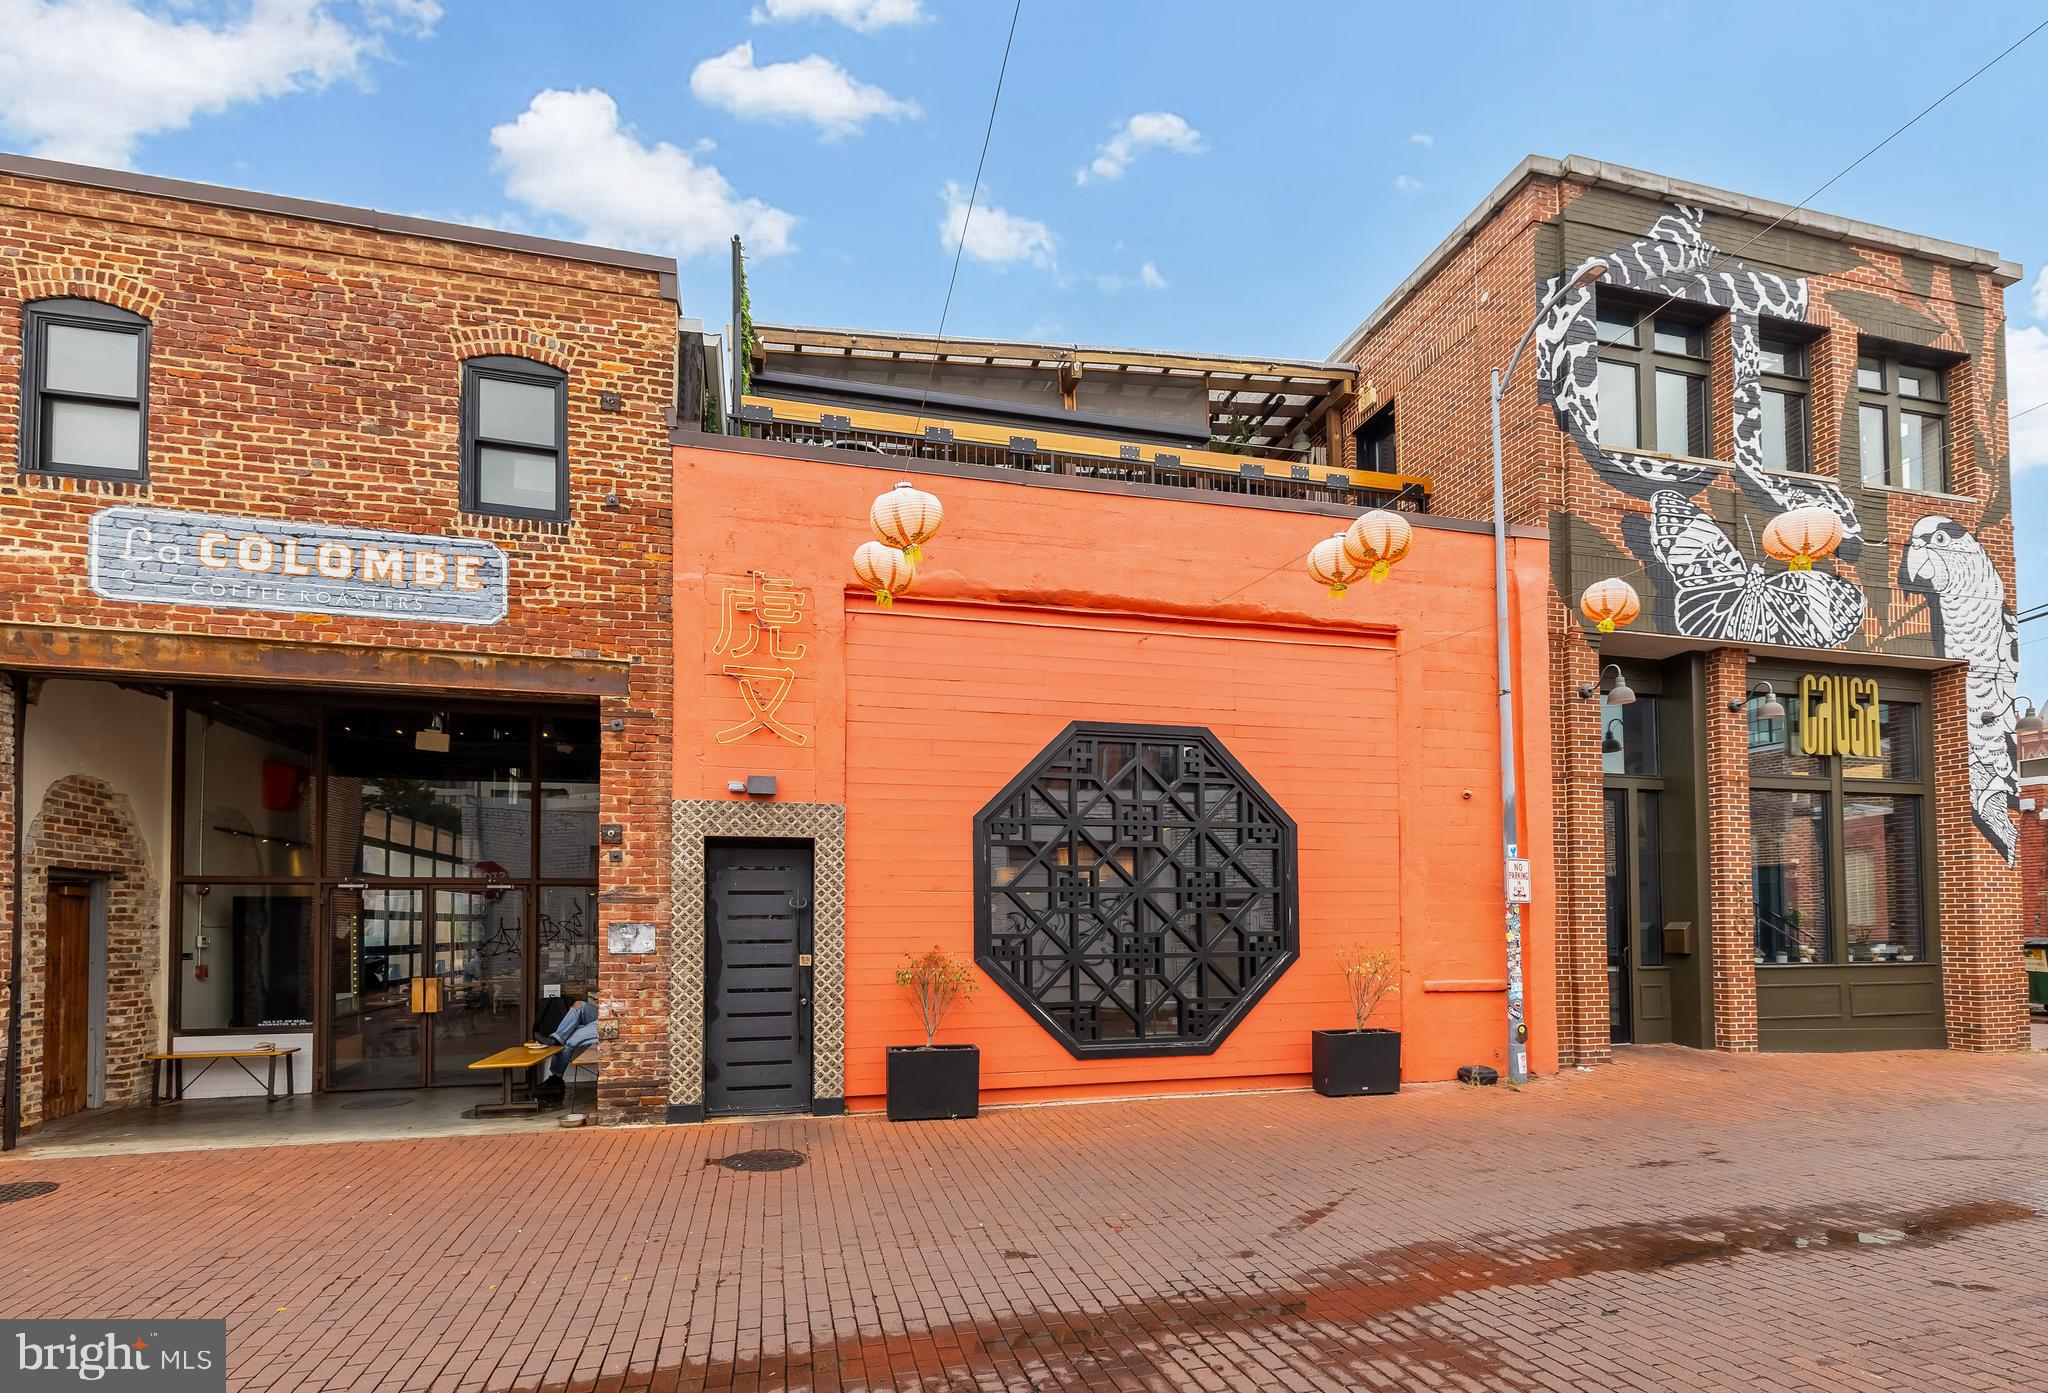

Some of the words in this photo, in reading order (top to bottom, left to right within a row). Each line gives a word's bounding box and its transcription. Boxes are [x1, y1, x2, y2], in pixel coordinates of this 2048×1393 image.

[120, 527, 184, 564] La
[198, 531, 484, 591] COLOMBE
[191, 581, 286, 601] COFFEE
[300, 590, 424, 610] ROASTERS
[1801, 674, 1882, 757] CAUSA
[1508, 871, 1529, 880] PARKING
[1513, 863, 1523, 872] NO
